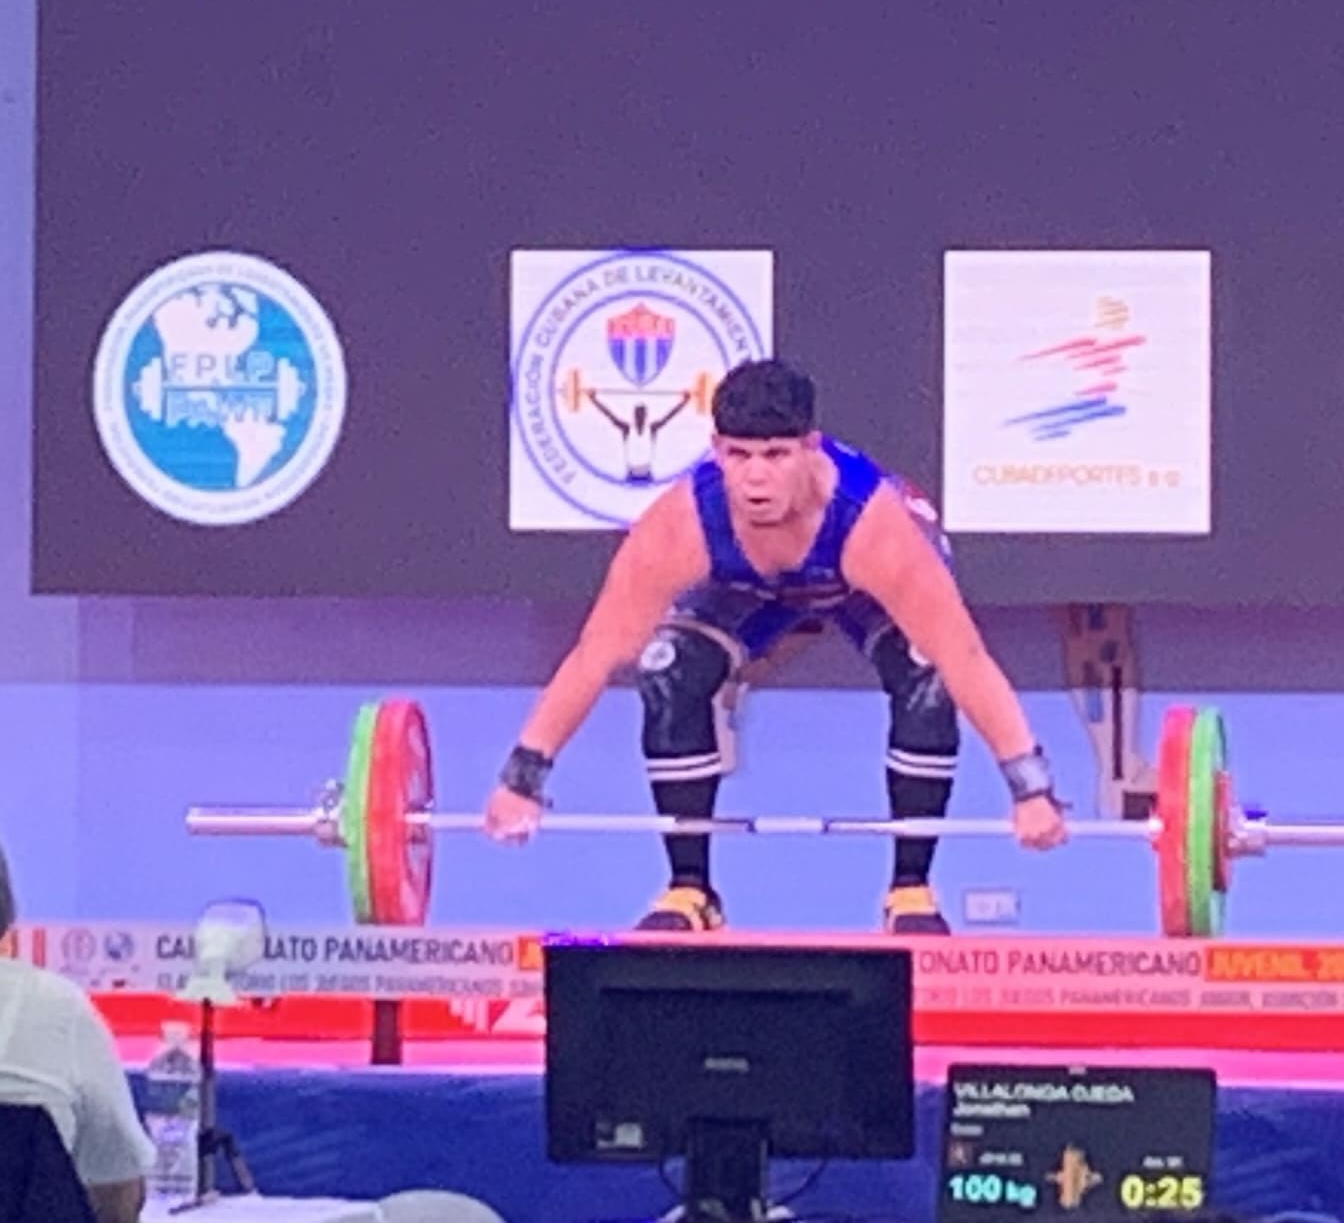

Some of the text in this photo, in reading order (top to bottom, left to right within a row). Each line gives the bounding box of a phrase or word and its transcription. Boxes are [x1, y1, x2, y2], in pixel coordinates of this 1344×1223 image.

[536, 277, 600, 349] CUBANA
[602, 265, 630, 287] DE
[973, 463, 1141, 487] CUBADEPORTES
[324, 934, 514, 965] PANAMERICANO
[1007, 949, 1202, 977] PANAMERICANO
[947, 1174, 1038, 1209] 100 kg
[1120, 1175, 1204, 1209] 0:25
